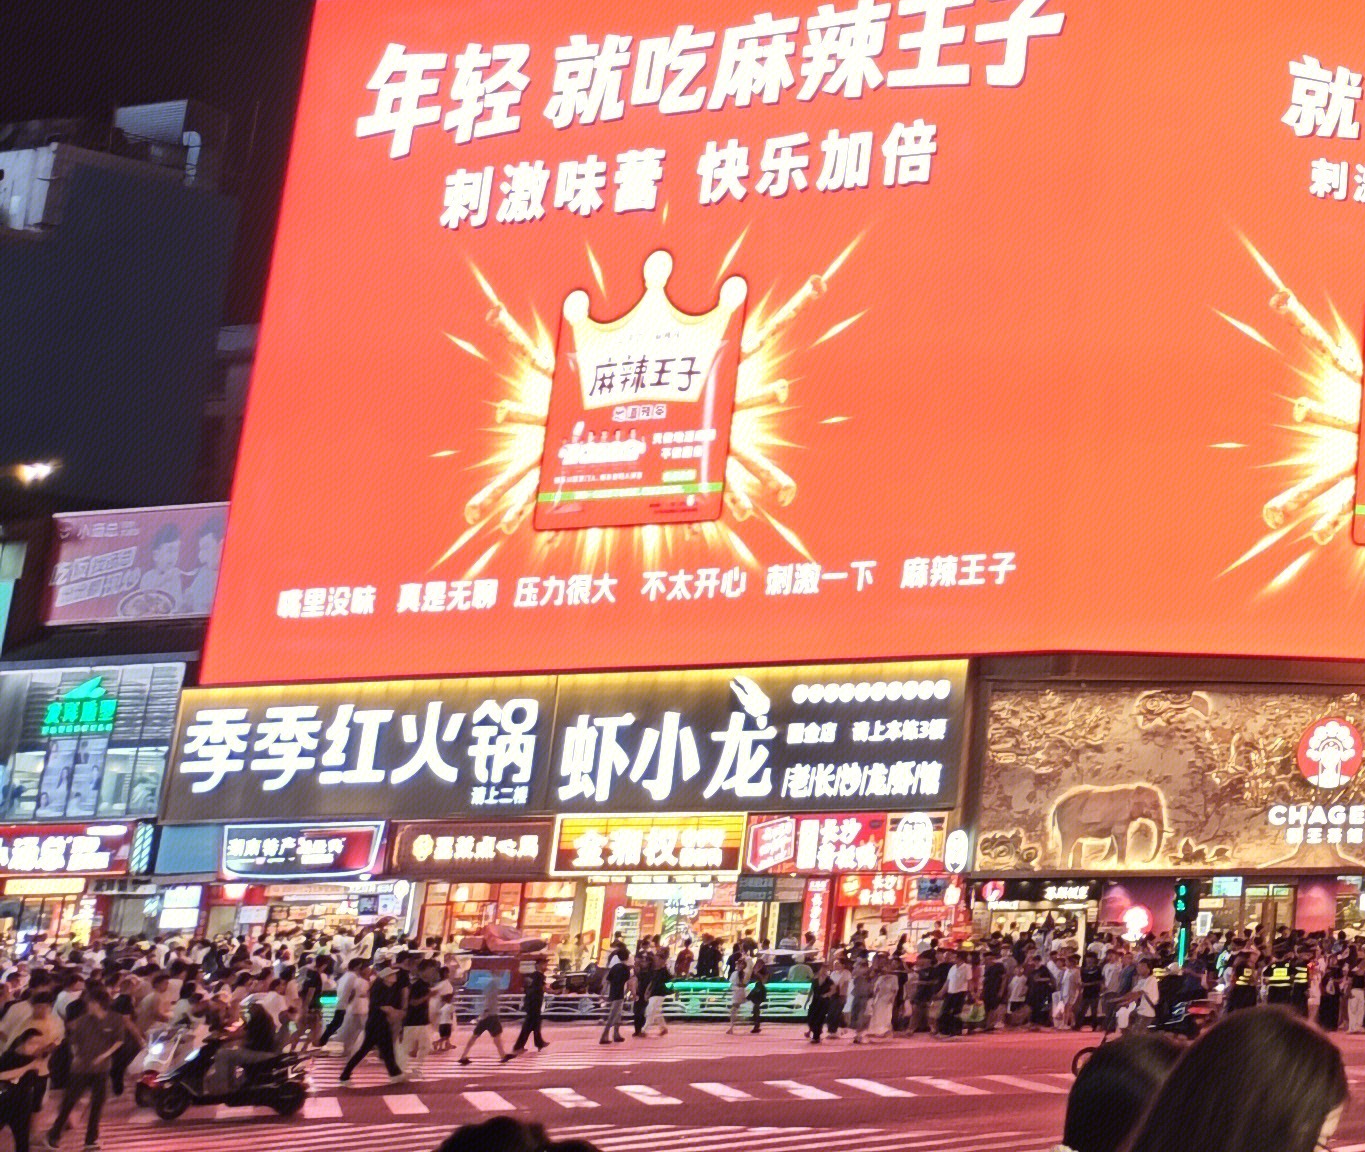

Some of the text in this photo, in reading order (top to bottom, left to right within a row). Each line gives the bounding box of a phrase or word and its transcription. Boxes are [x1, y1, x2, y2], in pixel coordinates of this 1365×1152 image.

[355, 43, 532, 159] 年轻
[440, 120, 939, 230] 刺激味蕾 快乐加倍
[589, 354, 701, 397] 麻辣王子
[275, 552, 1017, 619] 嘴里没味 真是无聊 压力很大 不太开心 刺激一下 麻辣王子
[180, 698, 540, 794] 季季红火锅
[558, 677, 779, 802] 虾小龙
